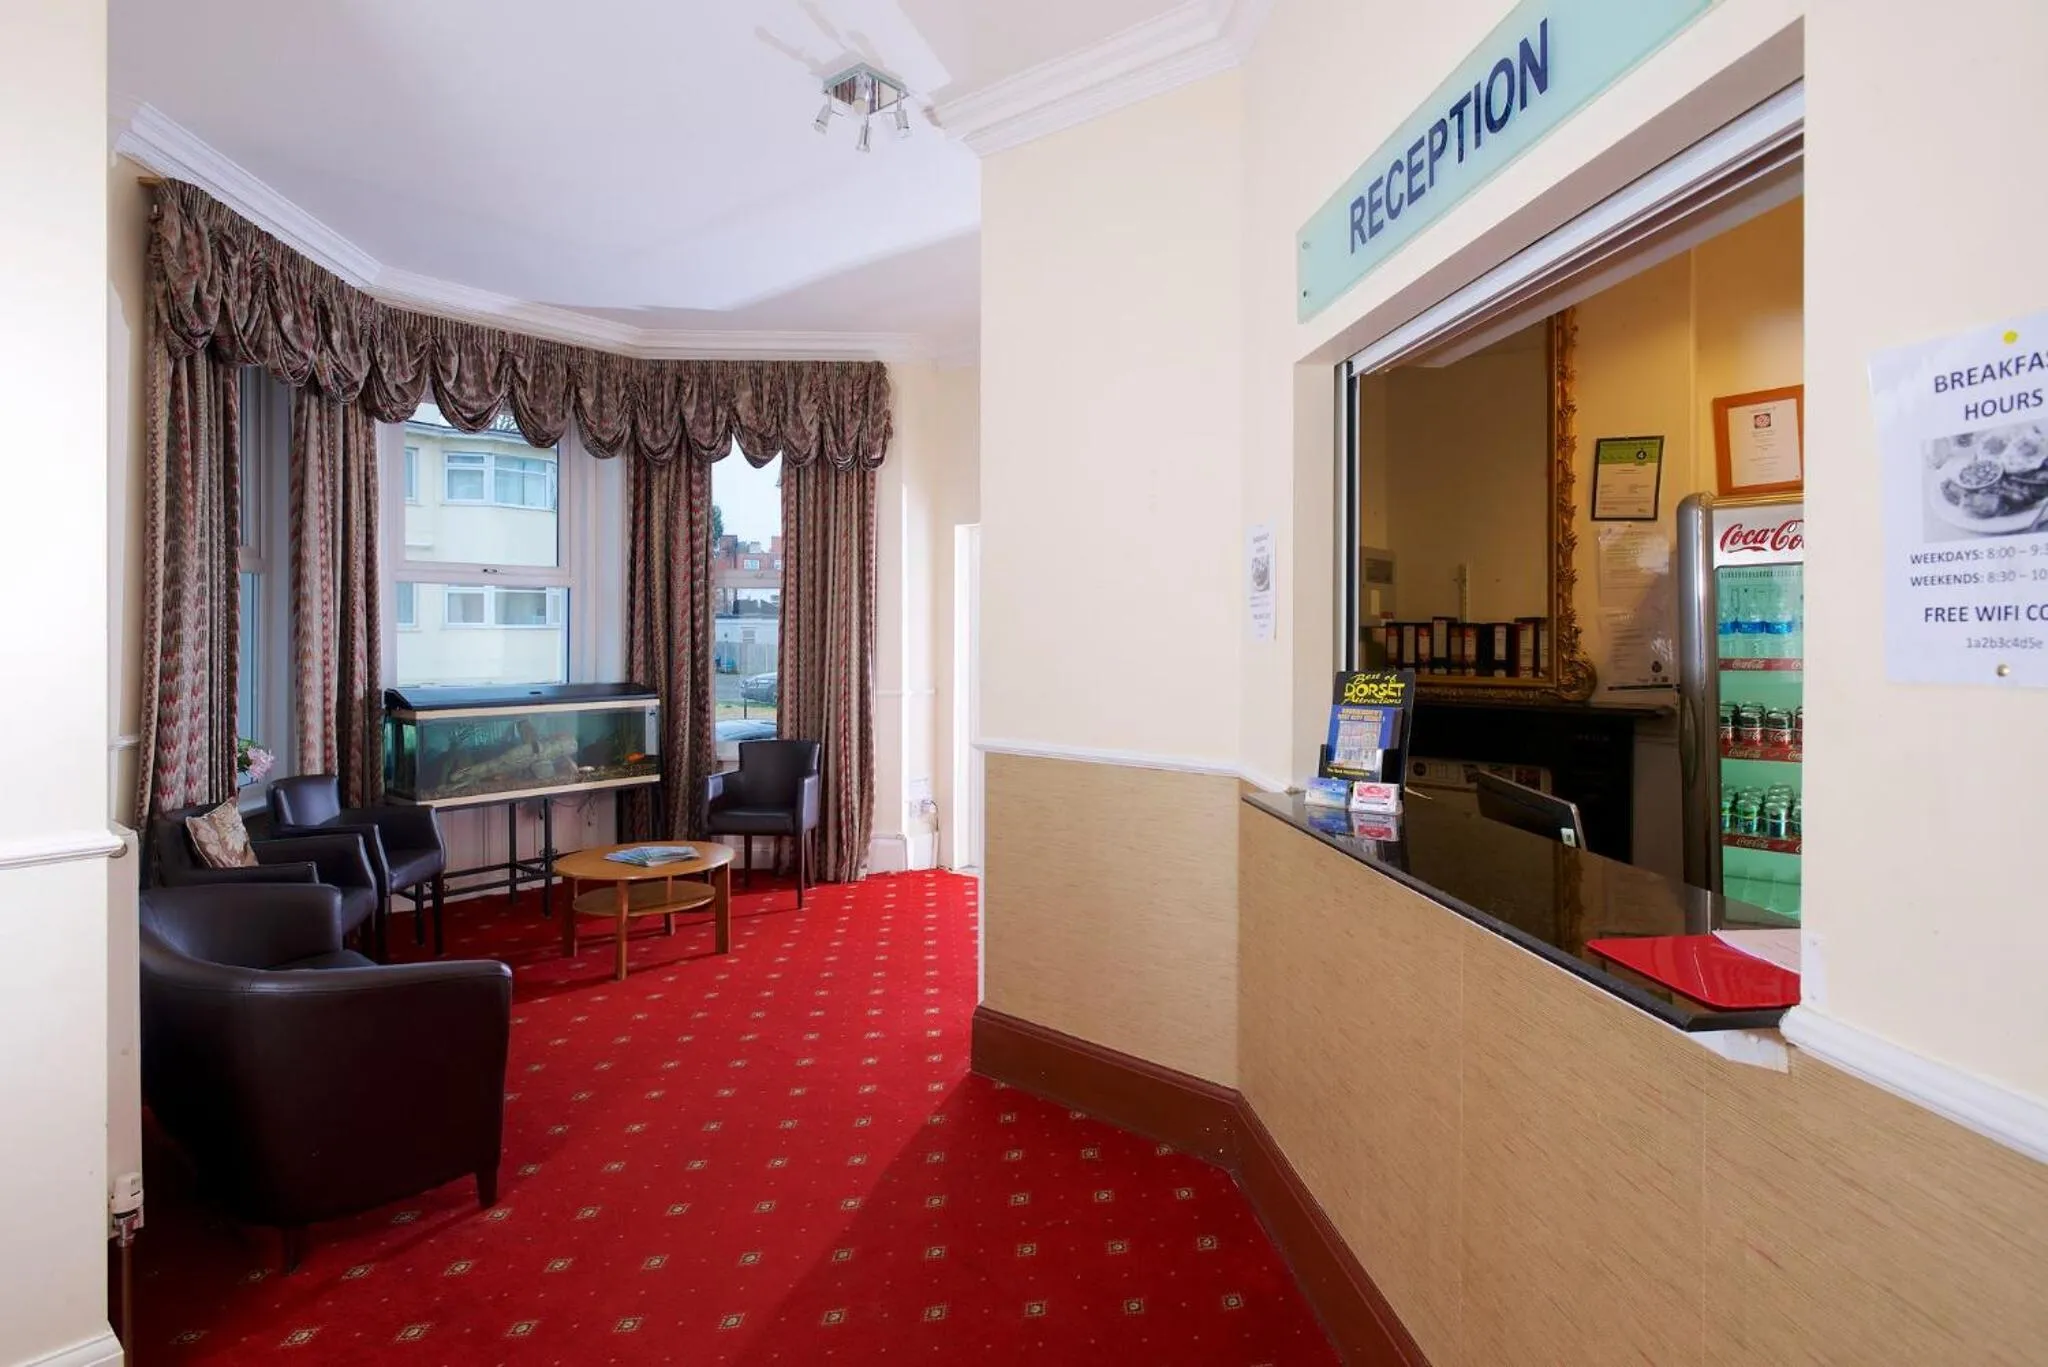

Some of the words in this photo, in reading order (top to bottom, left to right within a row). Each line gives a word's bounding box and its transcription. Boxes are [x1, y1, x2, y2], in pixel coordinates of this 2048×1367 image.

[1350, 17, 1548, 255] RECEPTION
[1964, 387, 2044, 421] HOURS
[1719, 518, 1804, 553] Coca-Co
[1910, 549, 1984, 565] WEEKDAYS:
[1910, 572, 1985, 587] WEEKENDS:
[1986, 569, 2017, 583] 8:30
[1924, 606, 1969, 623] FREE
[1974, 605, 2020, 622] WIFI
[1966, 636, 2045, 650] 1a2b3c4d5e
[1344, 683, 1406, 698] DORSET
